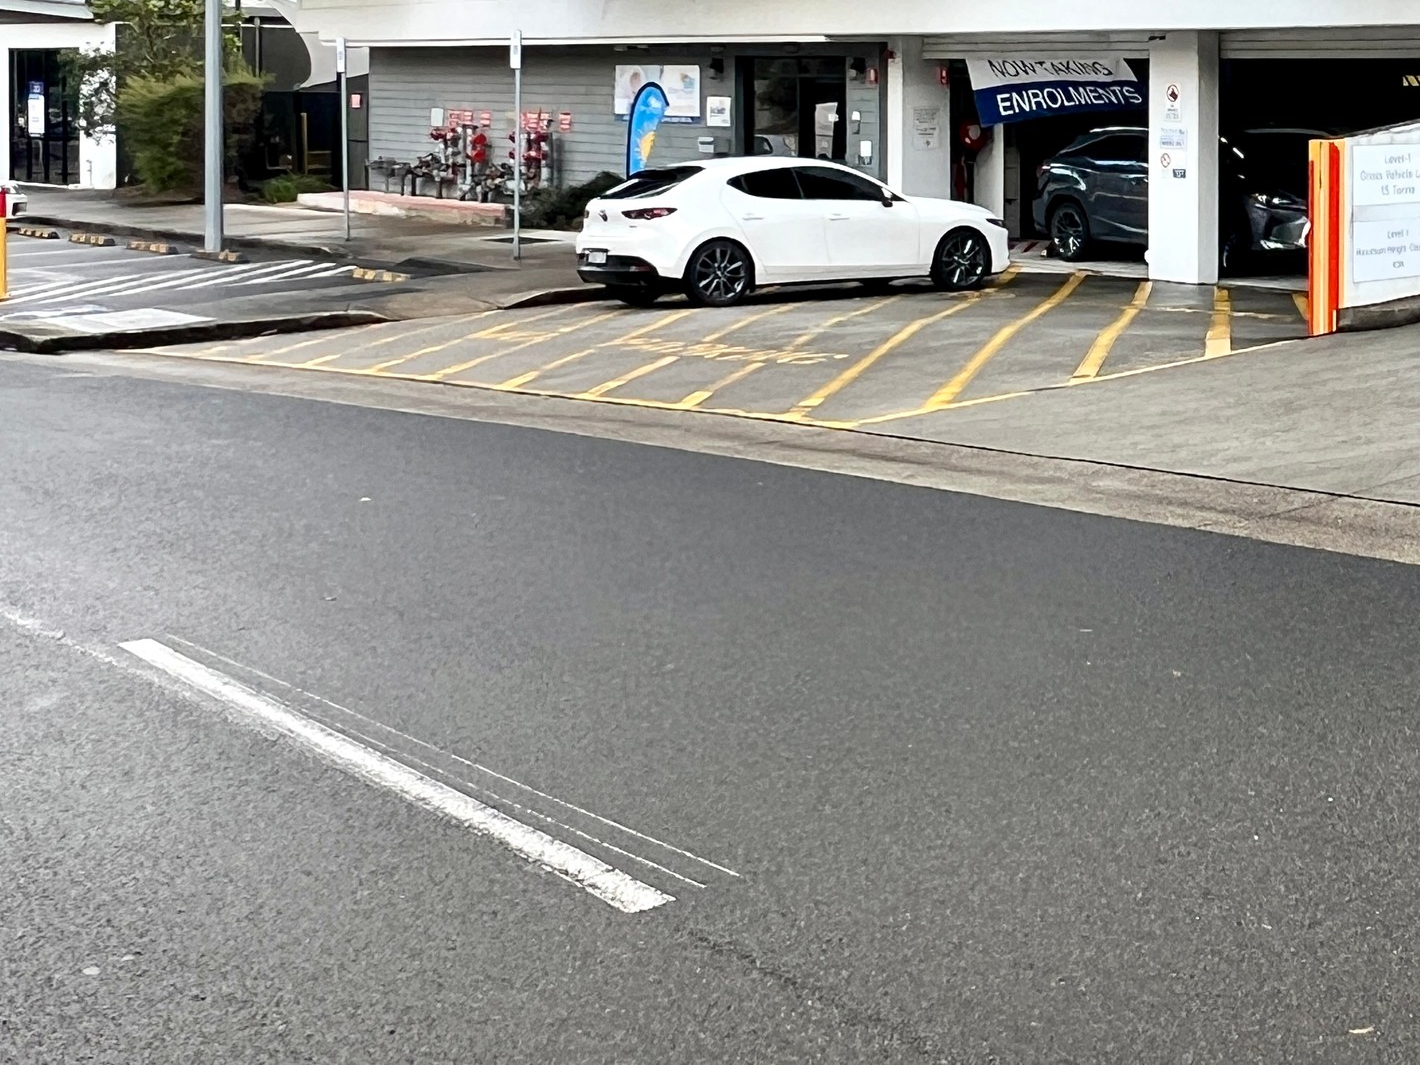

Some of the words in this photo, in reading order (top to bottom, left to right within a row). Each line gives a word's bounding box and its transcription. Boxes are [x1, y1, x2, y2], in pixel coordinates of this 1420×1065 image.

[987, 59, 1036, 78] NOW
[1036, 60, 1114, 77] TAKING
[996, 86, 1143, 116] ENROLMENTS
